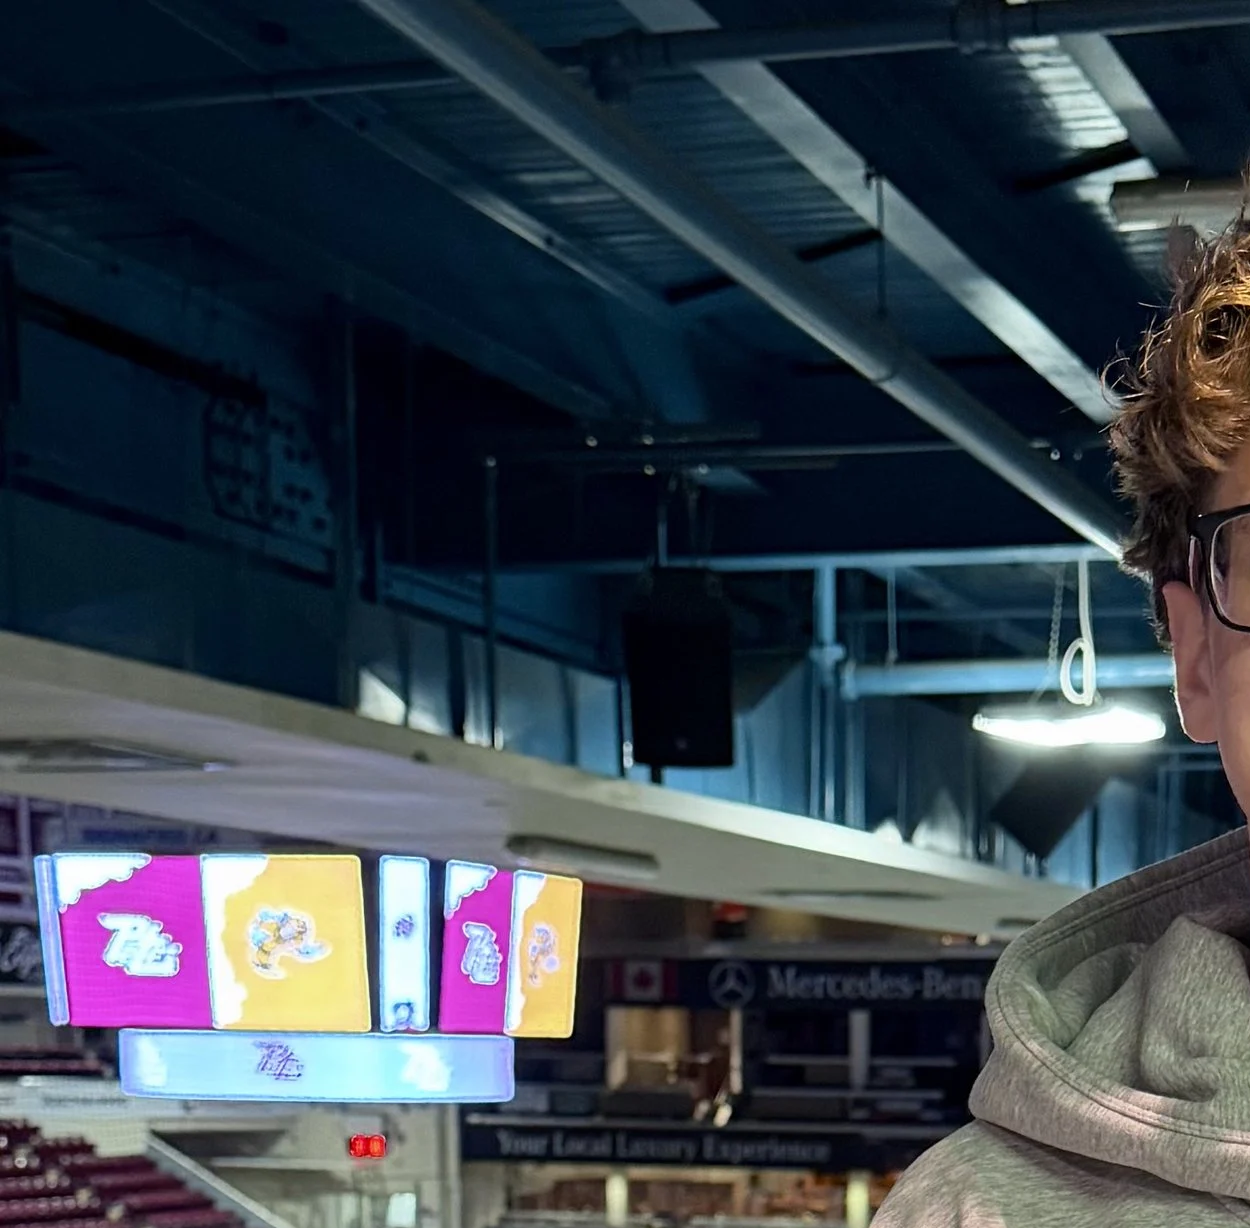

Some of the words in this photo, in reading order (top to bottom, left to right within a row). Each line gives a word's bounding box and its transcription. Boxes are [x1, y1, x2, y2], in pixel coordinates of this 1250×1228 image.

[768, 965, 982, 999] Mercedes-Ben
[496, 1130, 548, 1156] Your
[553, 1130, 611, 1157] Local
[703, 1132, 832, 1164] Experience
